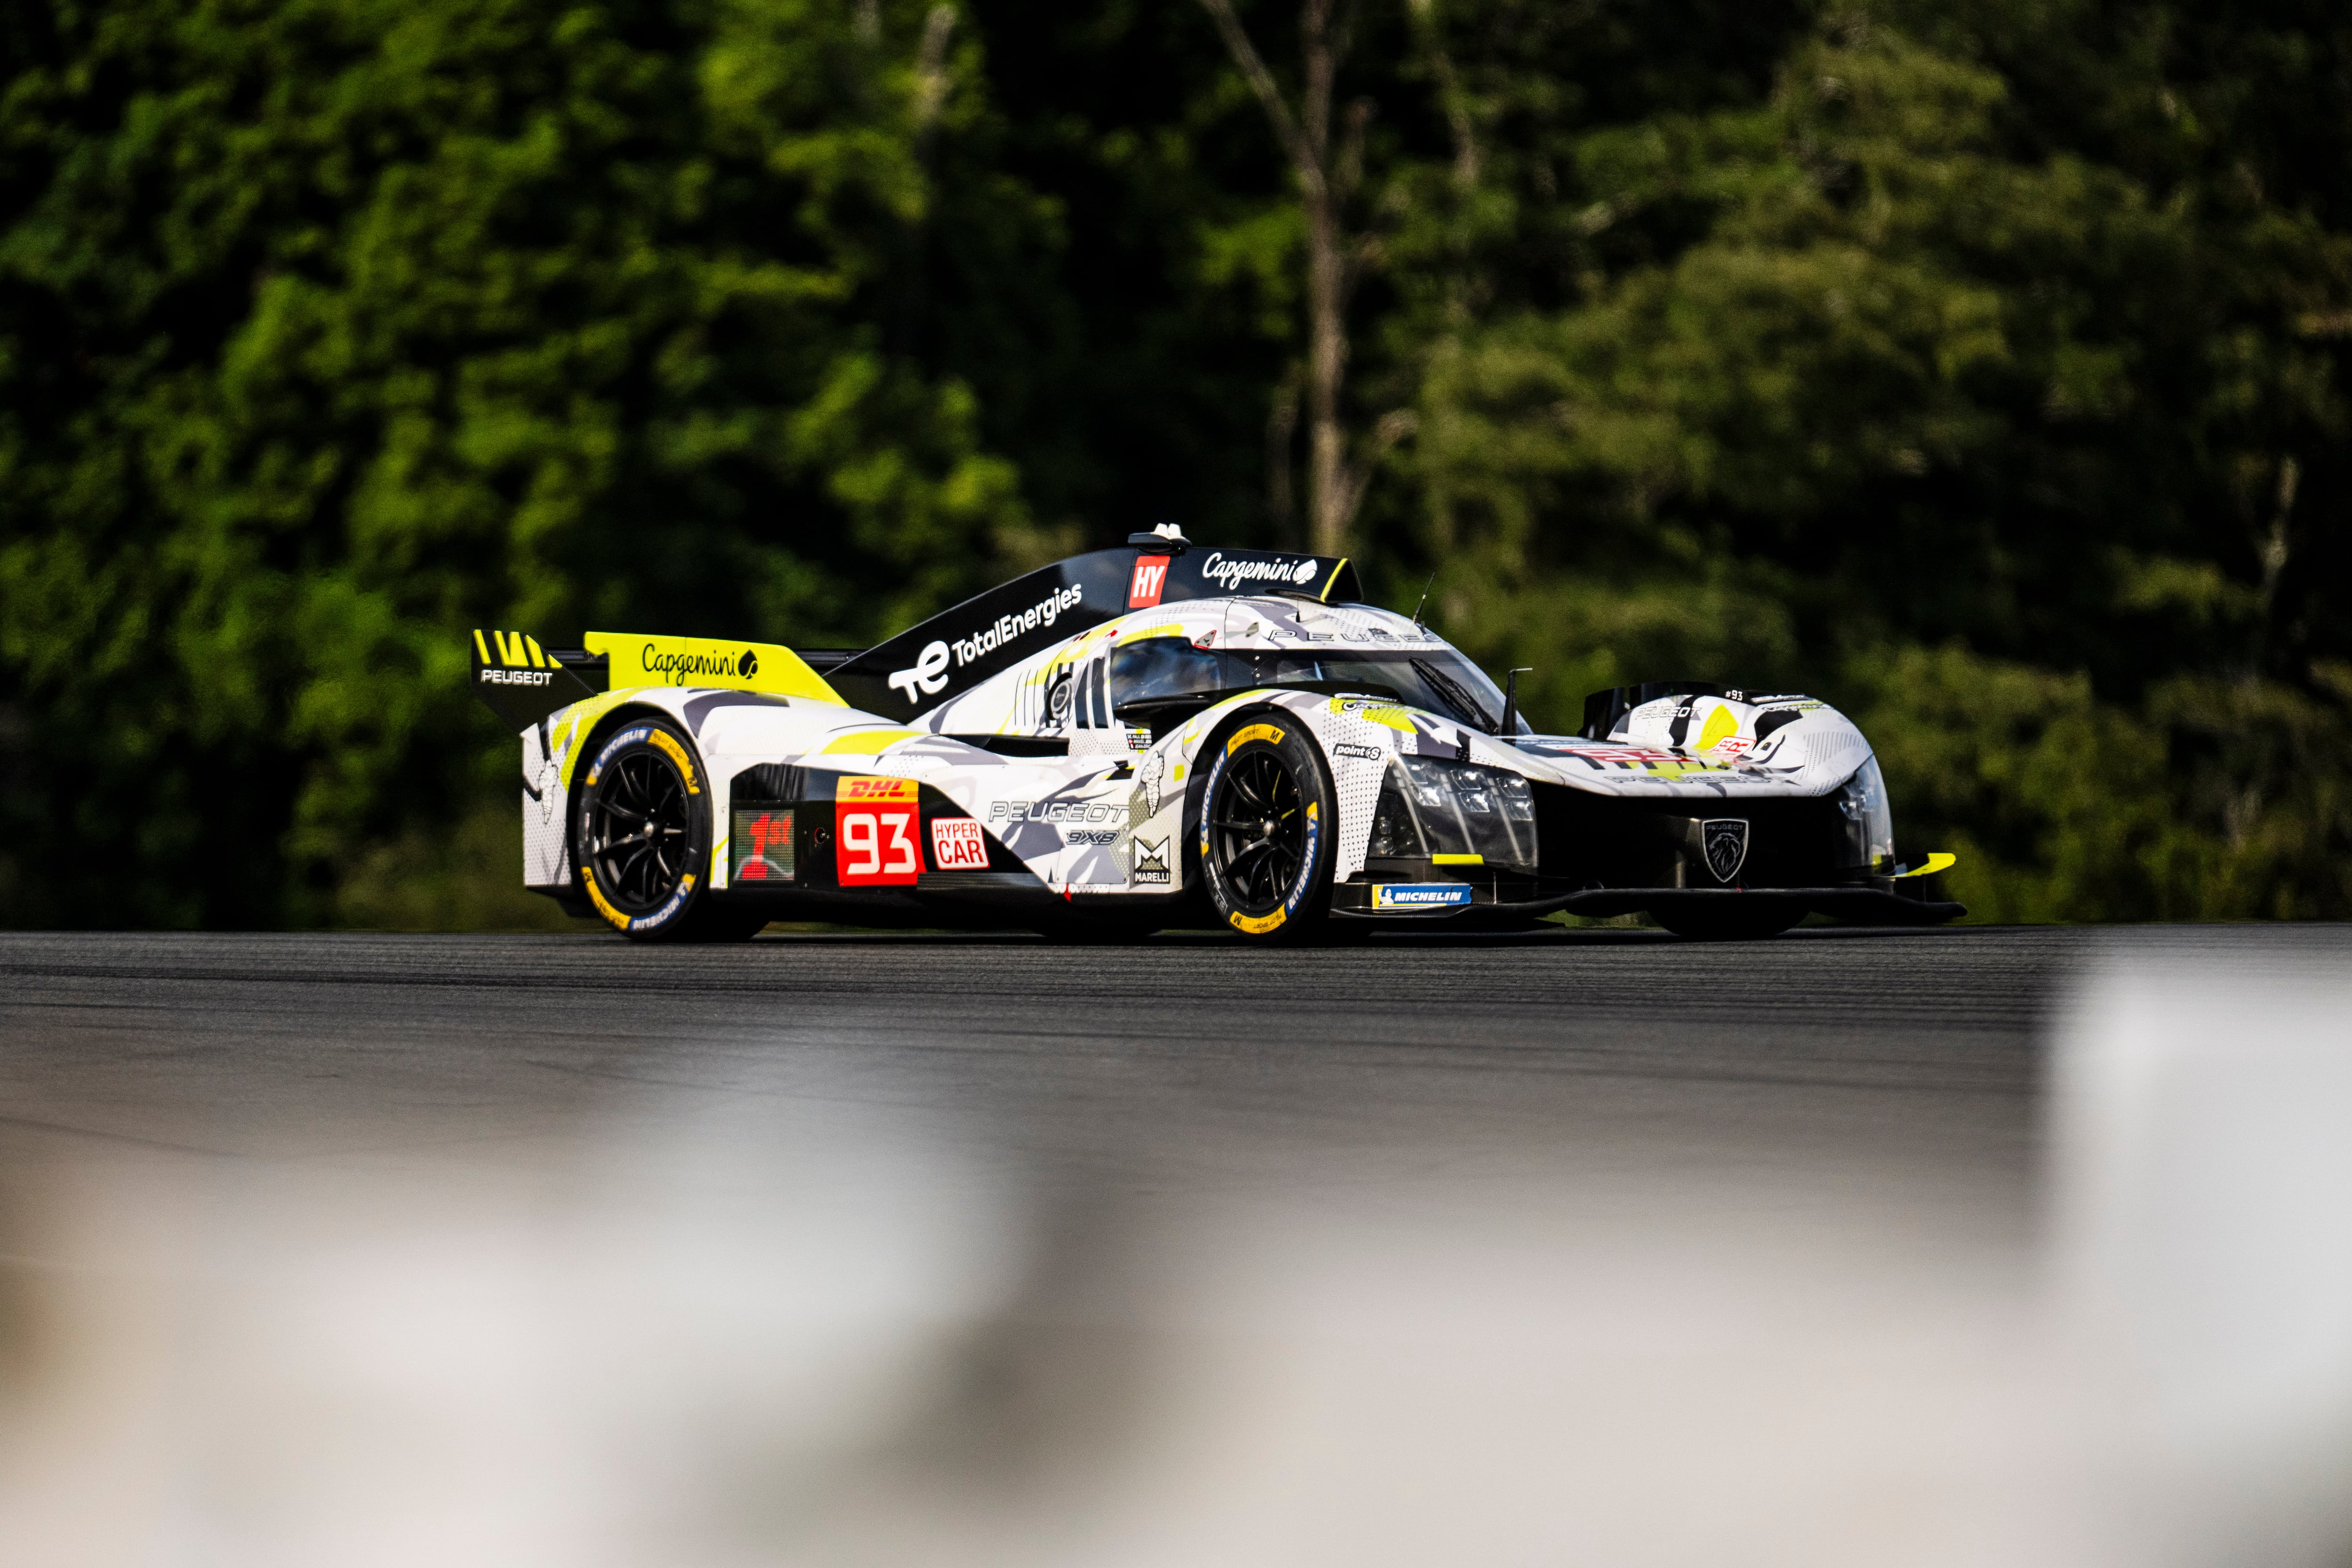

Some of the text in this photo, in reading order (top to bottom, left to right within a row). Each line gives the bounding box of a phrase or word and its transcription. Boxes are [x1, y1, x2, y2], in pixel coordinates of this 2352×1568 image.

[1133, 566, 1165, 597] HY
[1203, 552, 1298, 590] Capgemini
[952, 584, 1081, 667] TotalEnergies
[643, 643, 736, 686] Capgemini
[481, 669, 552, 687] PEUGEOT
[1725, 689, 1743, 701] #93
[1635, 706, 1701, 720] PEUGEOT
[1270, 729, 1280, 741] M
[600, 729, 647, 764] MICHELIN
[1336, 745, 1366, 756] point
[848, 781, 906, 797] DHL
[1202, 752, 1224, 826] MICHELIN
[988, 801, 1129, 823] PEUGEOT
[936, 823, 979, 838] HYPER
[1065, 830, 1120, 845] 9X8
[742, 813, 791, 879] 1st
[843, 813, 916, 875] 93
[939, 839, 984, 863] CAR
[1135, 872, 1169, 882] MARELLI
[1288, 837, 1315, 910] MICHELIN
[1394, 892, 1462, 902] MICHELIN
